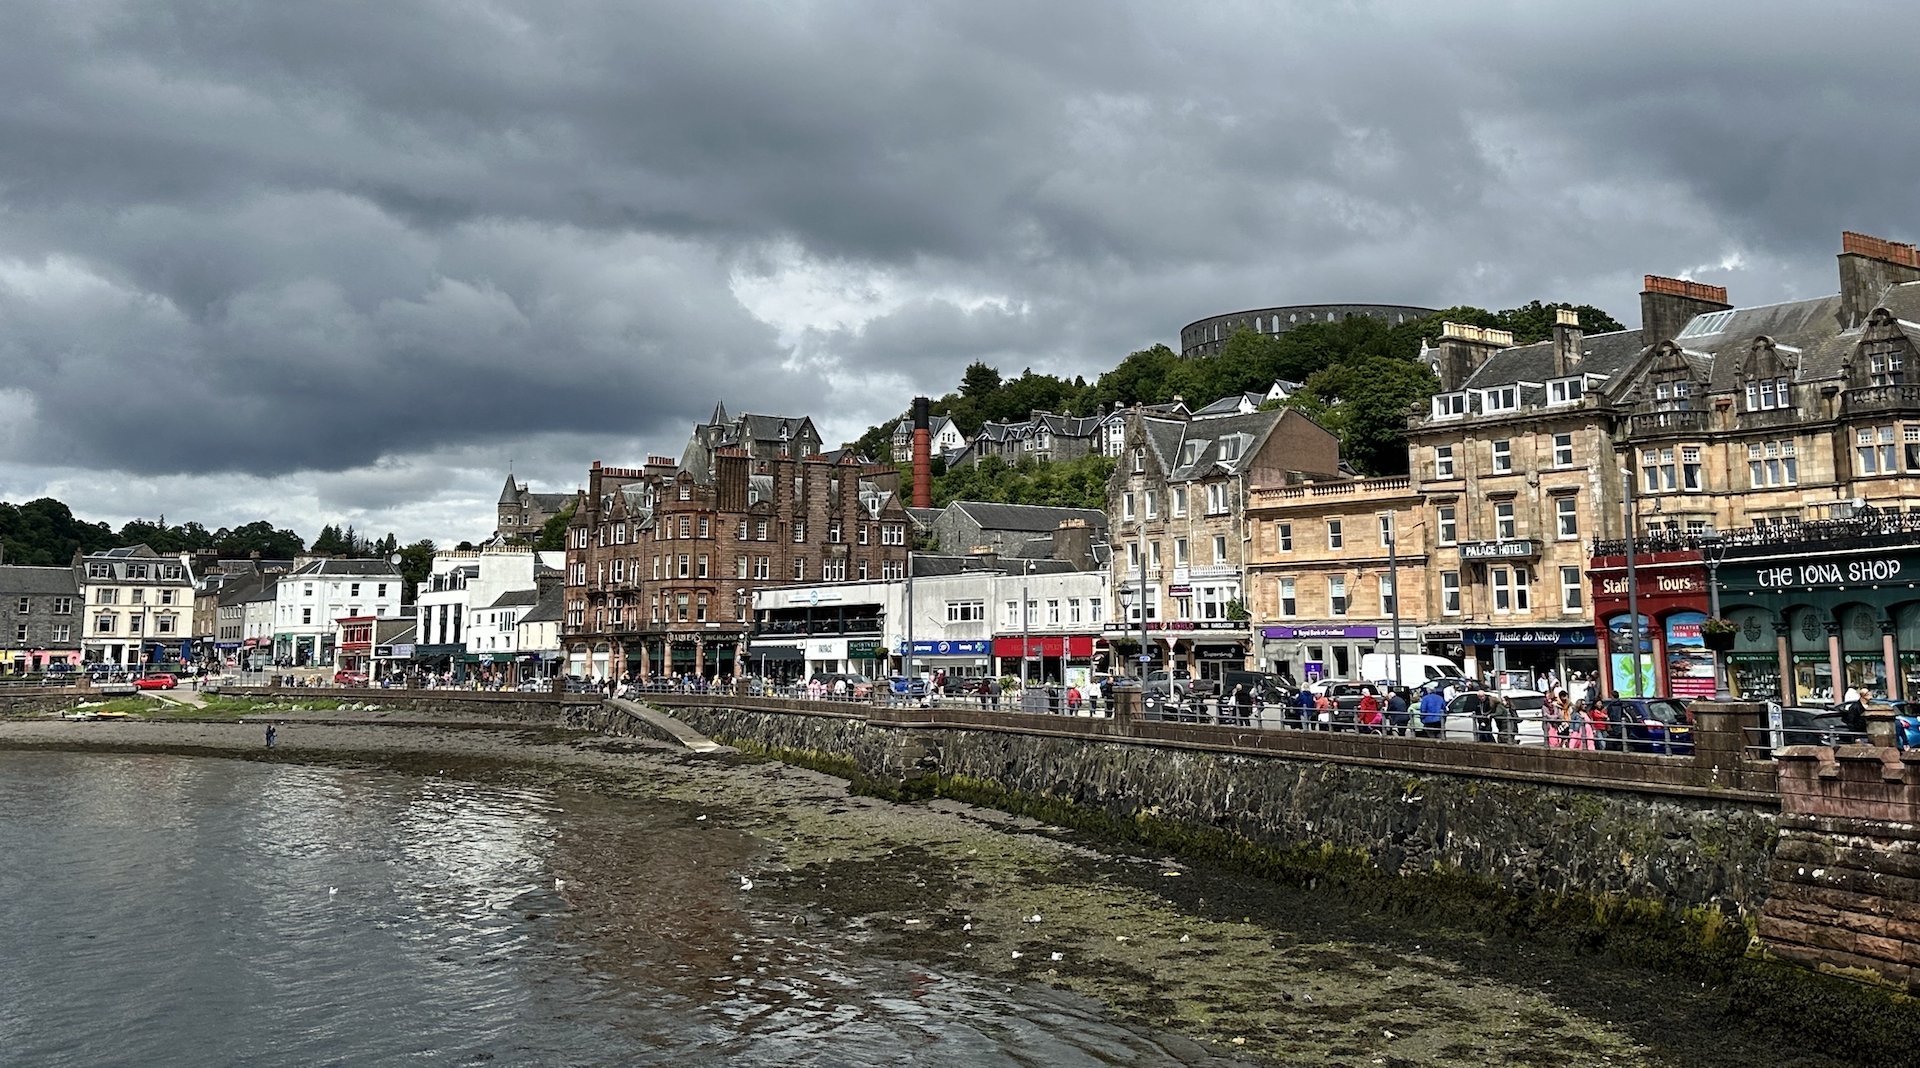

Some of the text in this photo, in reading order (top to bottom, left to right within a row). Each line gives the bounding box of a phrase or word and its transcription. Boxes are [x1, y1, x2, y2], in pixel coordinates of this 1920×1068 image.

[1466, 544, 1524, 557] PALACE HOTEL
[1757, 560, 1901, 587] THE IONA SHOP
[1603, 575, 1692, 594] Staff Tours
[1495, 631, 1561, 644] Thistle do Nicely
